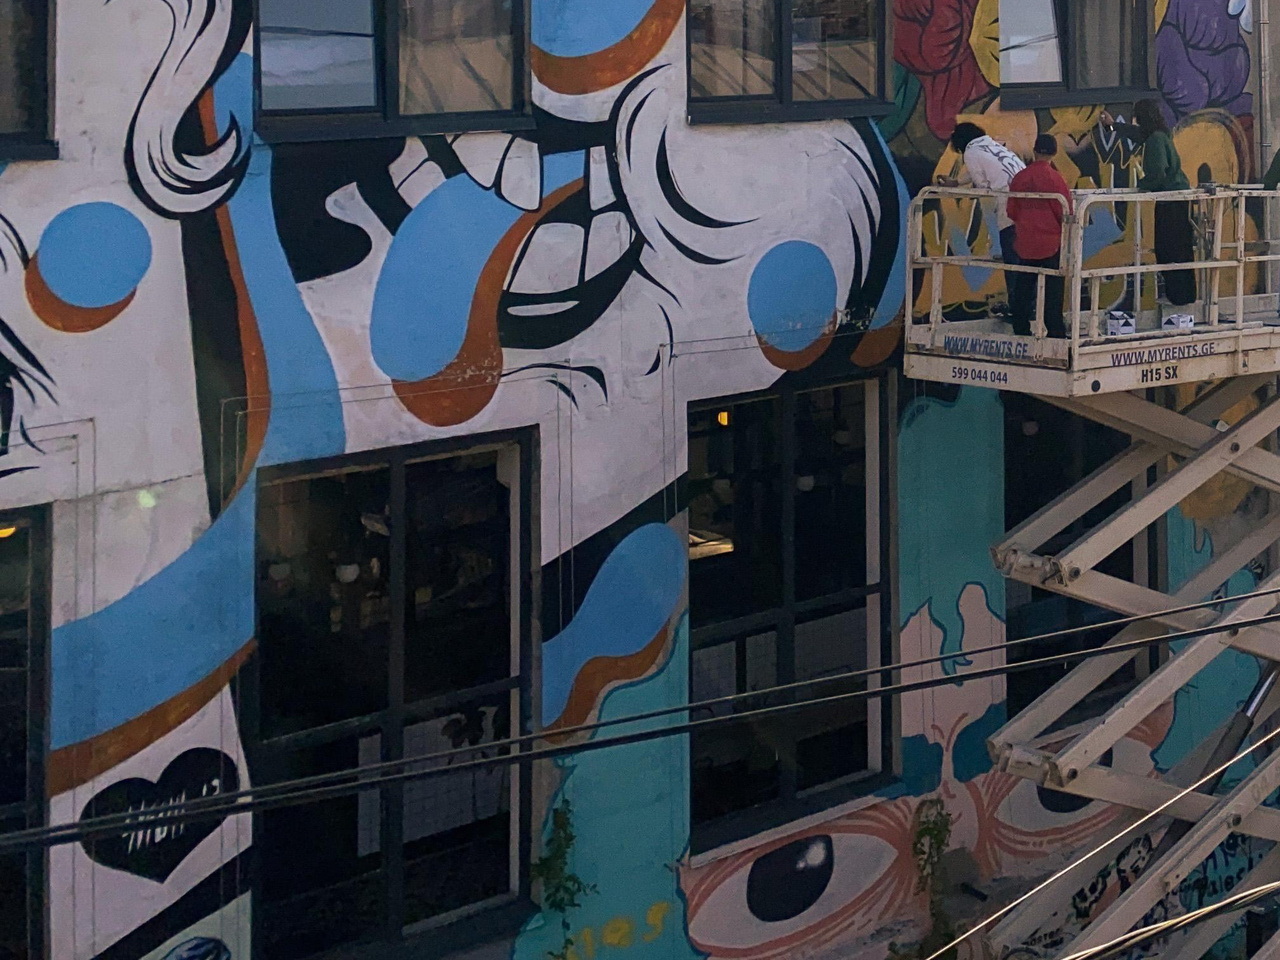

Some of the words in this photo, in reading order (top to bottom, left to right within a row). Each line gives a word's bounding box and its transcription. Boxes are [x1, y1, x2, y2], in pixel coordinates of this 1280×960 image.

[943, 335, 1029, 360] WWW.MYRENTS.GE
[1110, 342, 1216, 367] WWW.MYRENTS.GE
[951, 366, 968, 380] 599
[970, 367, 988, 382] 044
[990, 370, 1008, 384] 044
[1141, 367, 1162, 383] H15
[1164, 365, 1178, 380] SX
